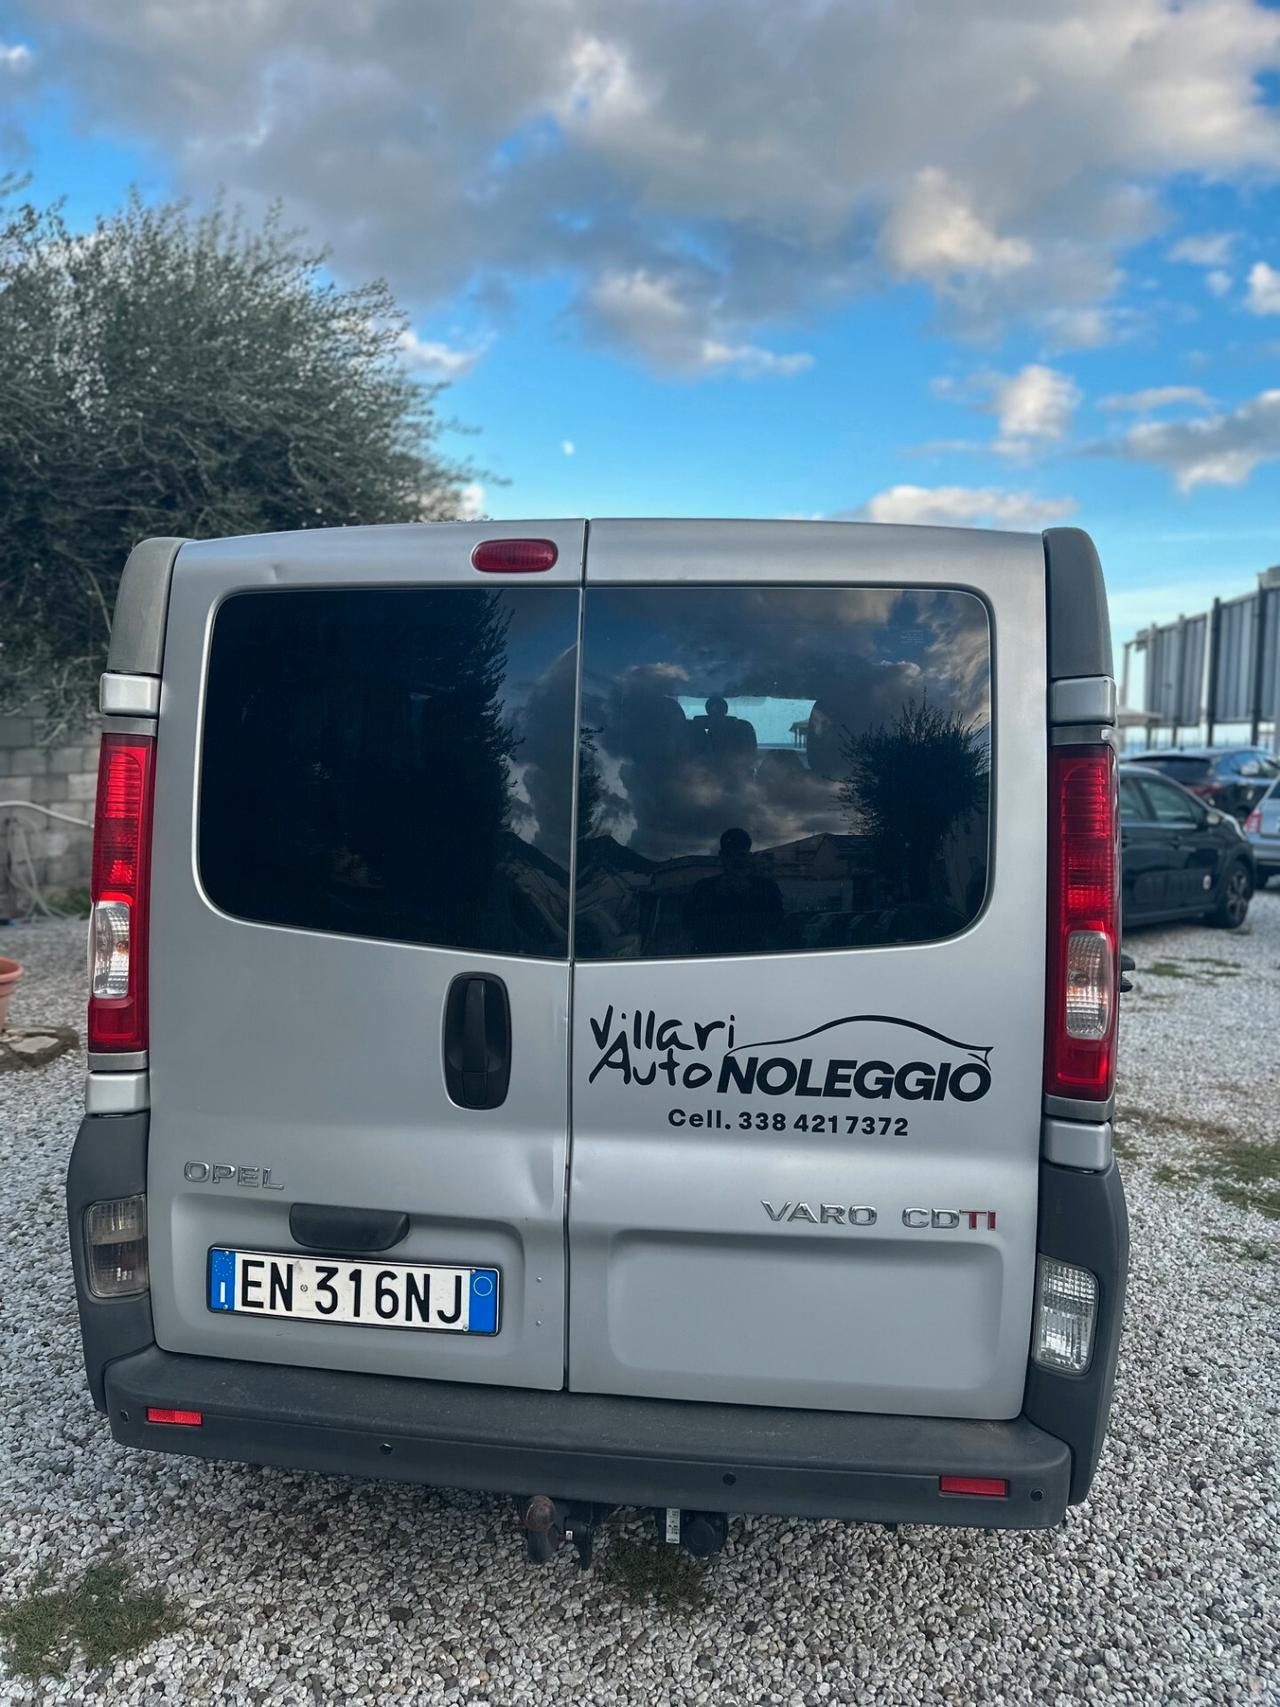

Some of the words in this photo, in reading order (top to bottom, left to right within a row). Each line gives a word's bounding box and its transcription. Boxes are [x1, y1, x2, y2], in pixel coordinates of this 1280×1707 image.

[589, 1004, 736, 1051] Villari
[667, 1108, 732, 1130] Cell.
[738, 1111, 787, 1132] 338
[183, 1160, 285, 1191] OPEL
[760, 1200, 878, 1226] VARO
[901, 1206, 997, 1231] CDTI
[241, 1259, 294, 1312] EN
[314, 1265, 463, 1325] 316NJ
